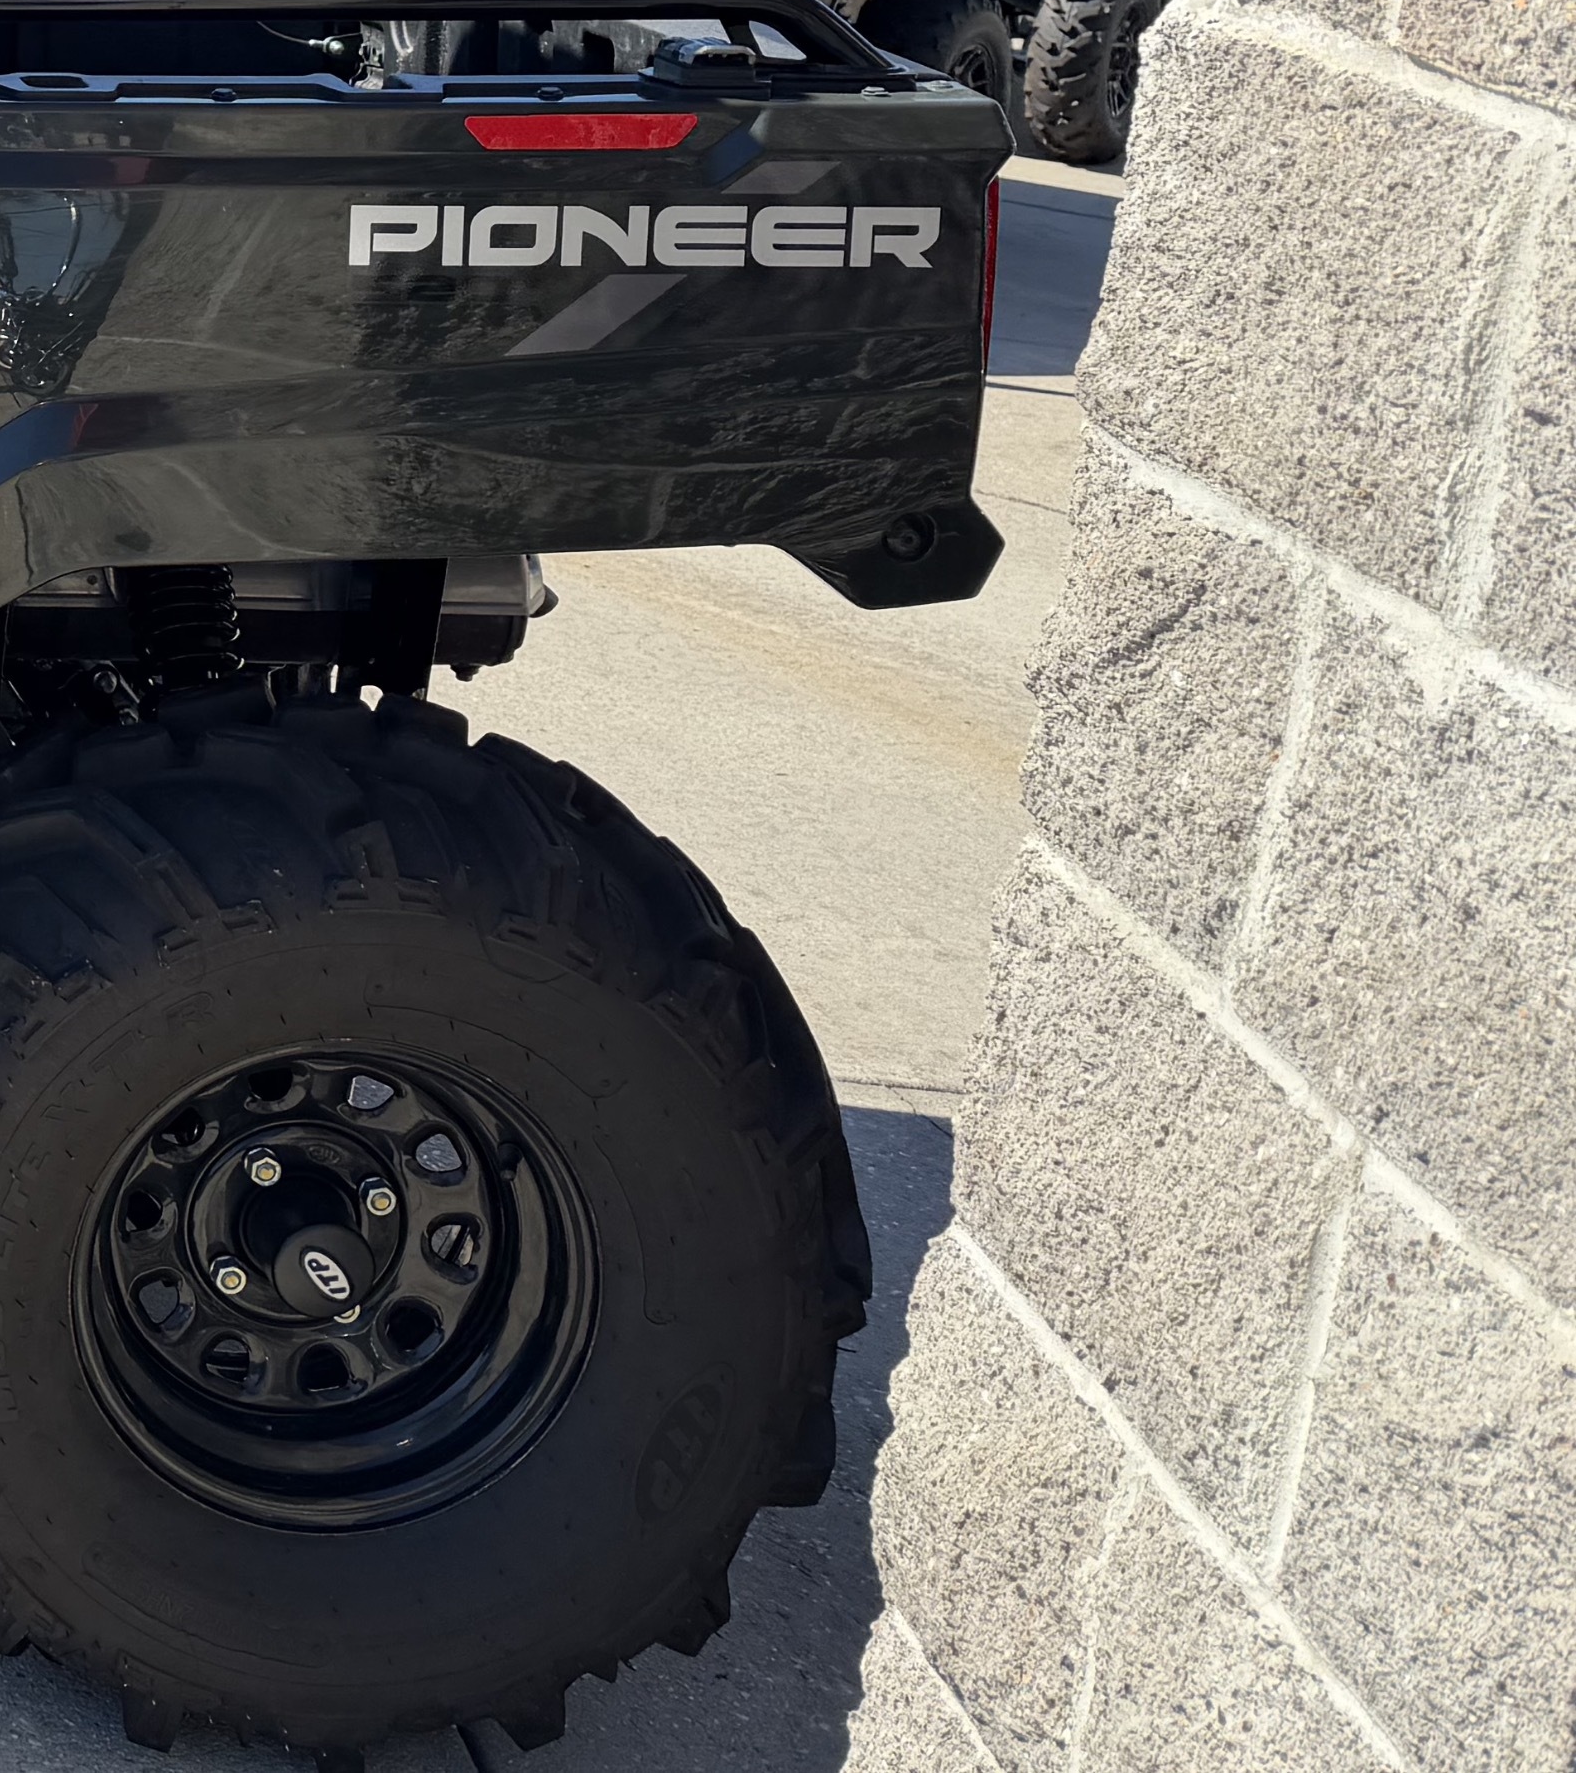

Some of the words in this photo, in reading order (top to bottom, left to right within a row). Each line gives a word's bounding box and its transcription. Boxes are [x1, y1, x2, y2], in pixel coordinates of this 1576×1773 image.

[349, 204, 941, 268] PIONEER
[307, 1257, 348, 1295] ITP
[649, 1395, 717, 1512] ITP
